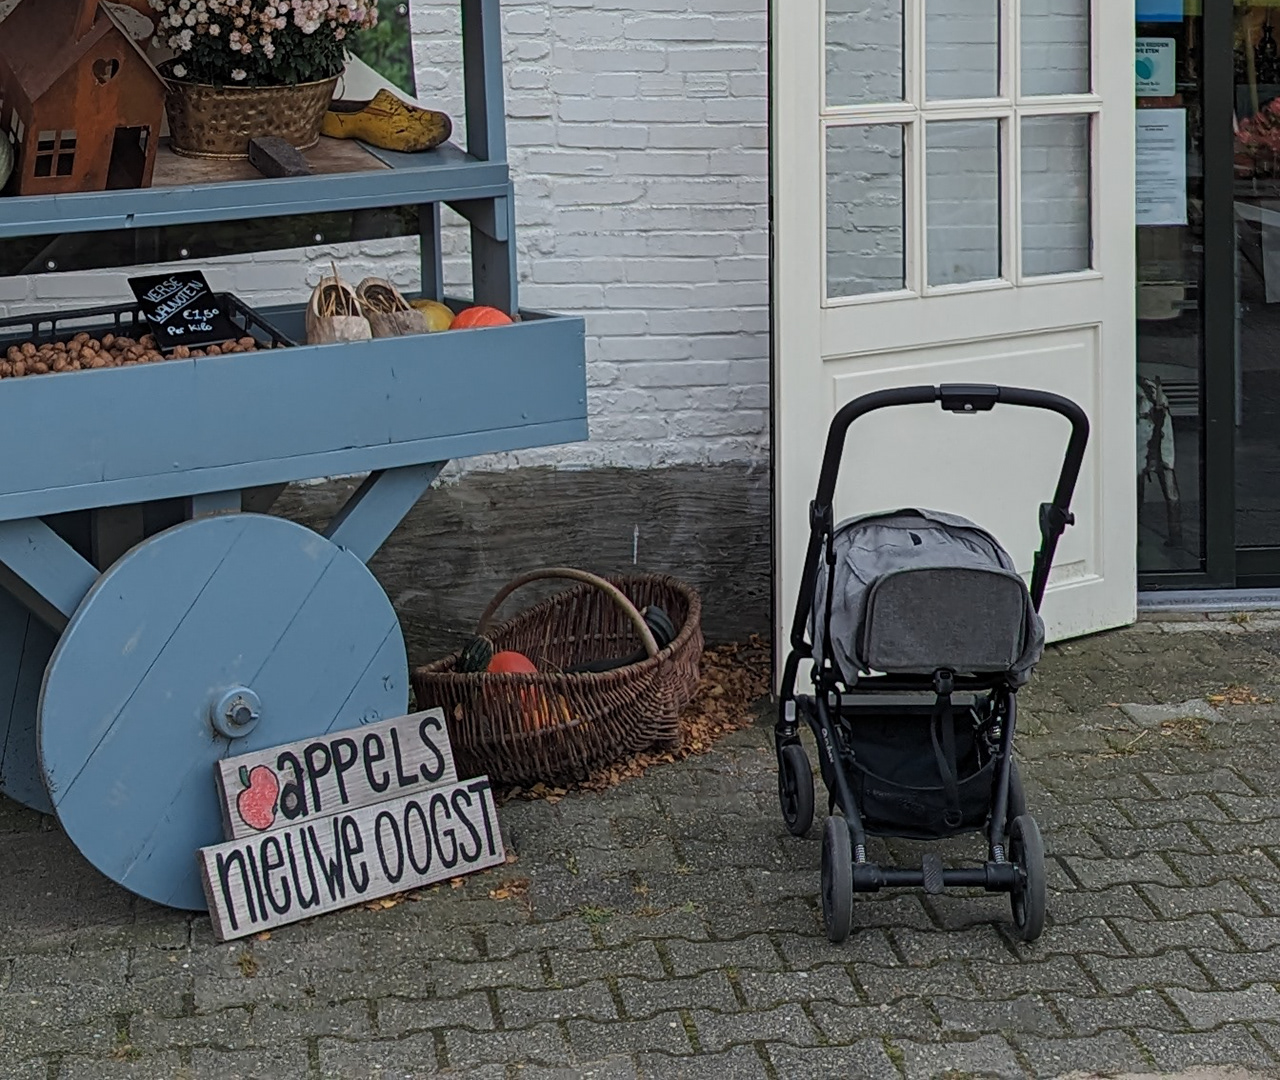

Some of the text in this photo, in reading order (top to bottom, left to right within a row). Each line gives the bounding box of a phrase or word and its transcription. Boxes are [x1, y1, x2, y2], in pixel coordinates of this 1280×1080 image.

[142, 276, 183, 302] VERSE
[147, 280, 204, 322] WALNOTEN
[374, 781, 497, 884] OOGST
